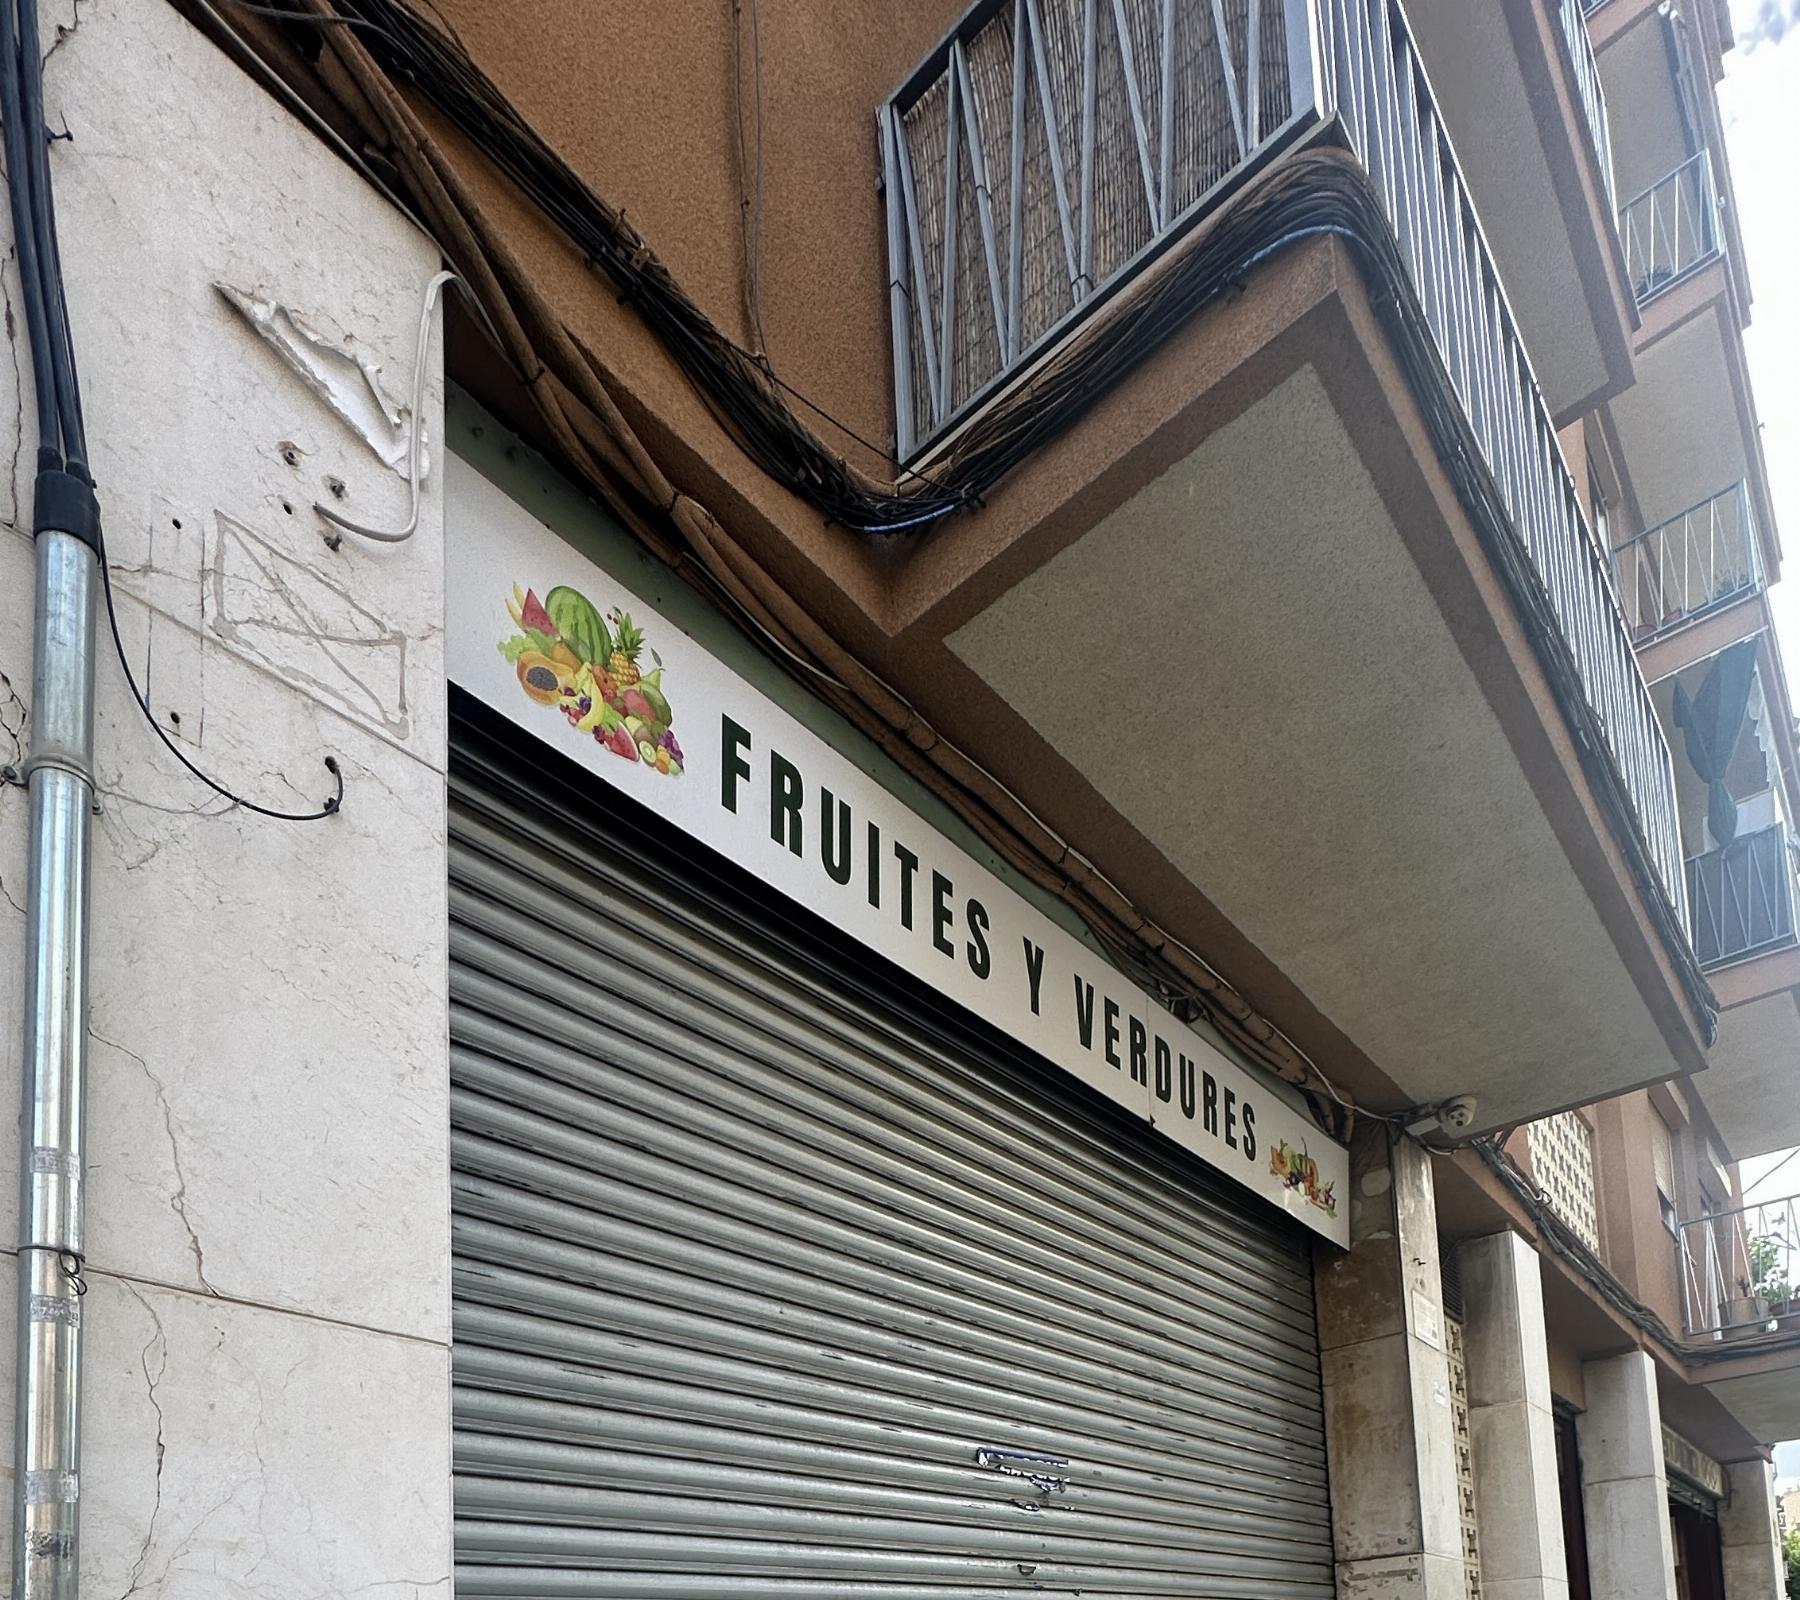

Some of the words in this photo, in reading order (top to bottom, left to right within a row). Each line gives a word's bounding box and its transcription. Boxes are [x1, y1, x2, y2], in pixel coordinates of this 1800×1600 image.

[721, 713, 991, 980] FRUITES
[1022, 935, 1045, 1017] Y
[1073, 973, 1257, 1162] VERDURES
